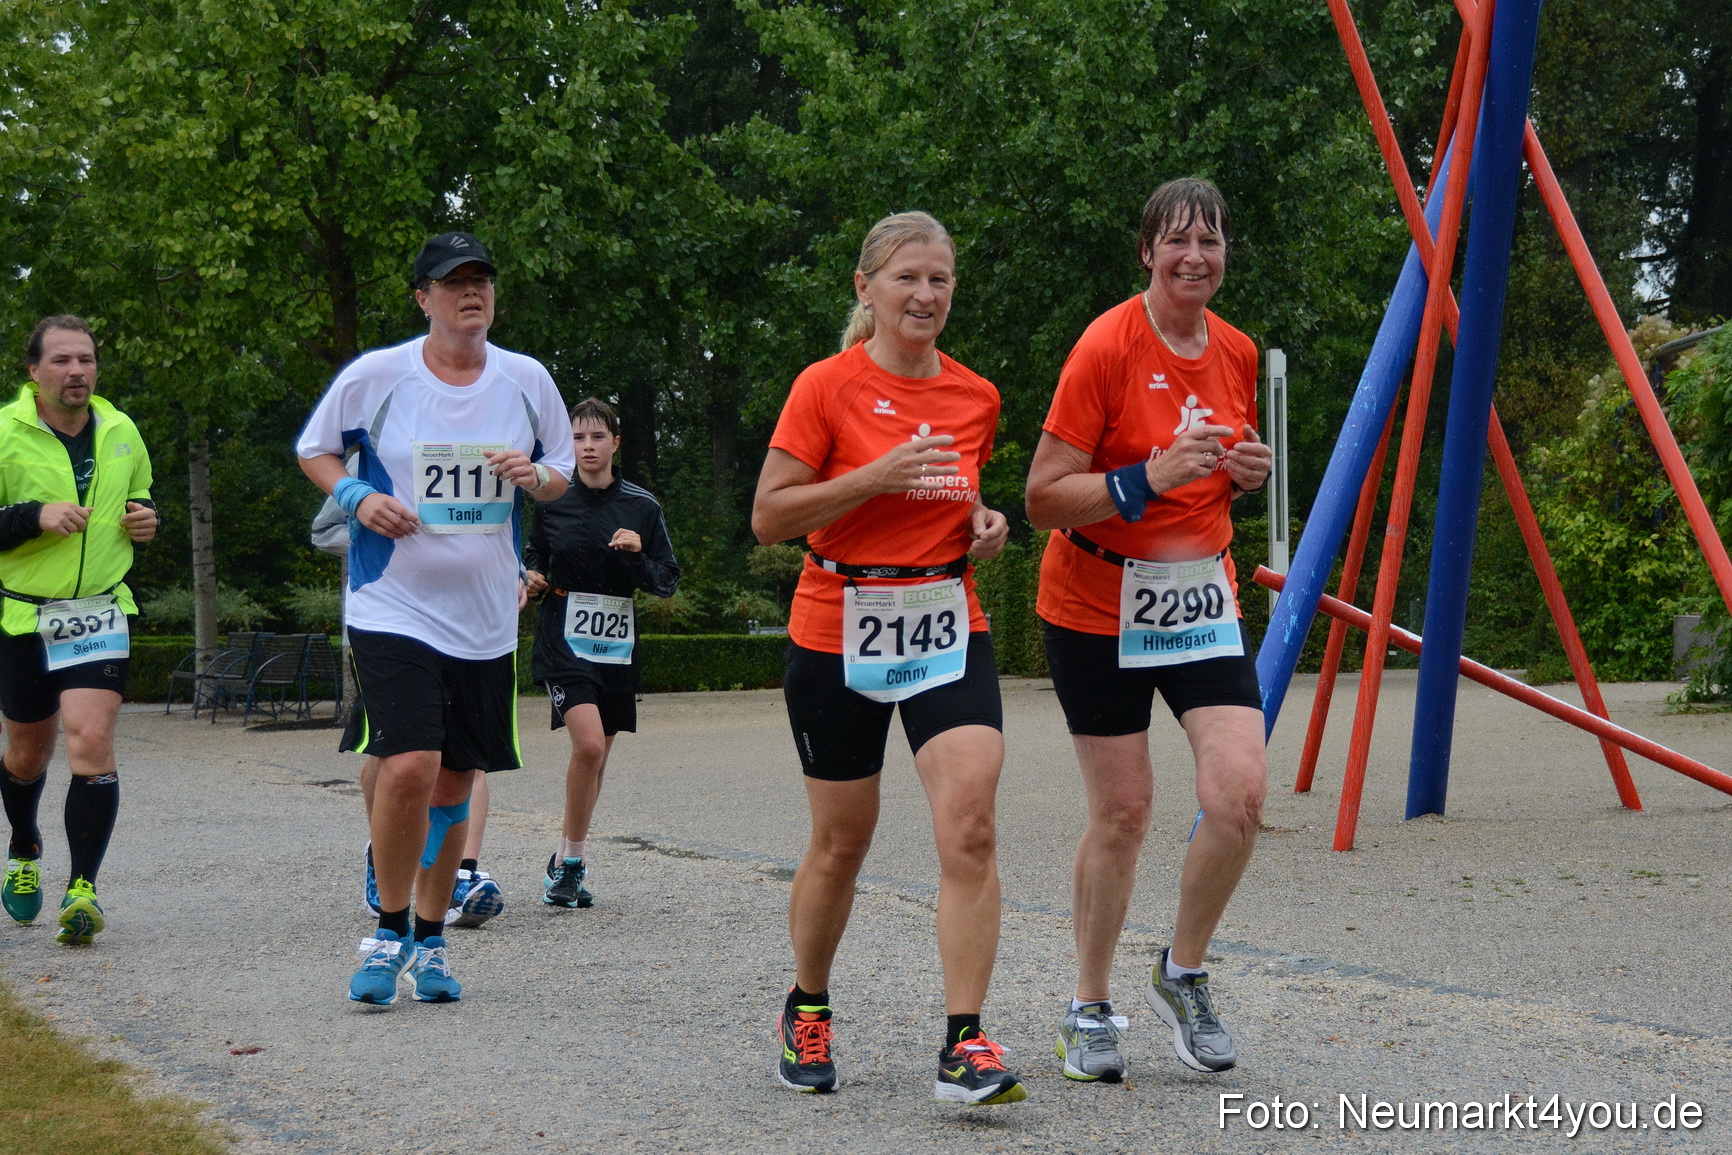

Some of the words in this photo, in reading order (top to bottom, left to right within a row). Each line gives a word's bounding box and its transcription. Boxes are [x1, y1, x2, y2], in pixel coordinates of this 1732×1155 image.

[425, 465, 503, 498] 2111
[905, 487, 976, 503] neumarkt
[447, 508, 482, 523] Tanja
[1133, 572, 1171, 581] NeuerMarkt
[1177, 560, 1217, 579] BOCK
[903, 584, 956, 606] BOCK
[1133, 583, 1224, 627] 2290
[573, 610, 629, 639] 2025
[859, 610, 957, 657] 2143
[592, 643, 608, 653] Nia
[1143, 629, 1217, 651] Hildegard
[886, 665, 928, 685] Conny
